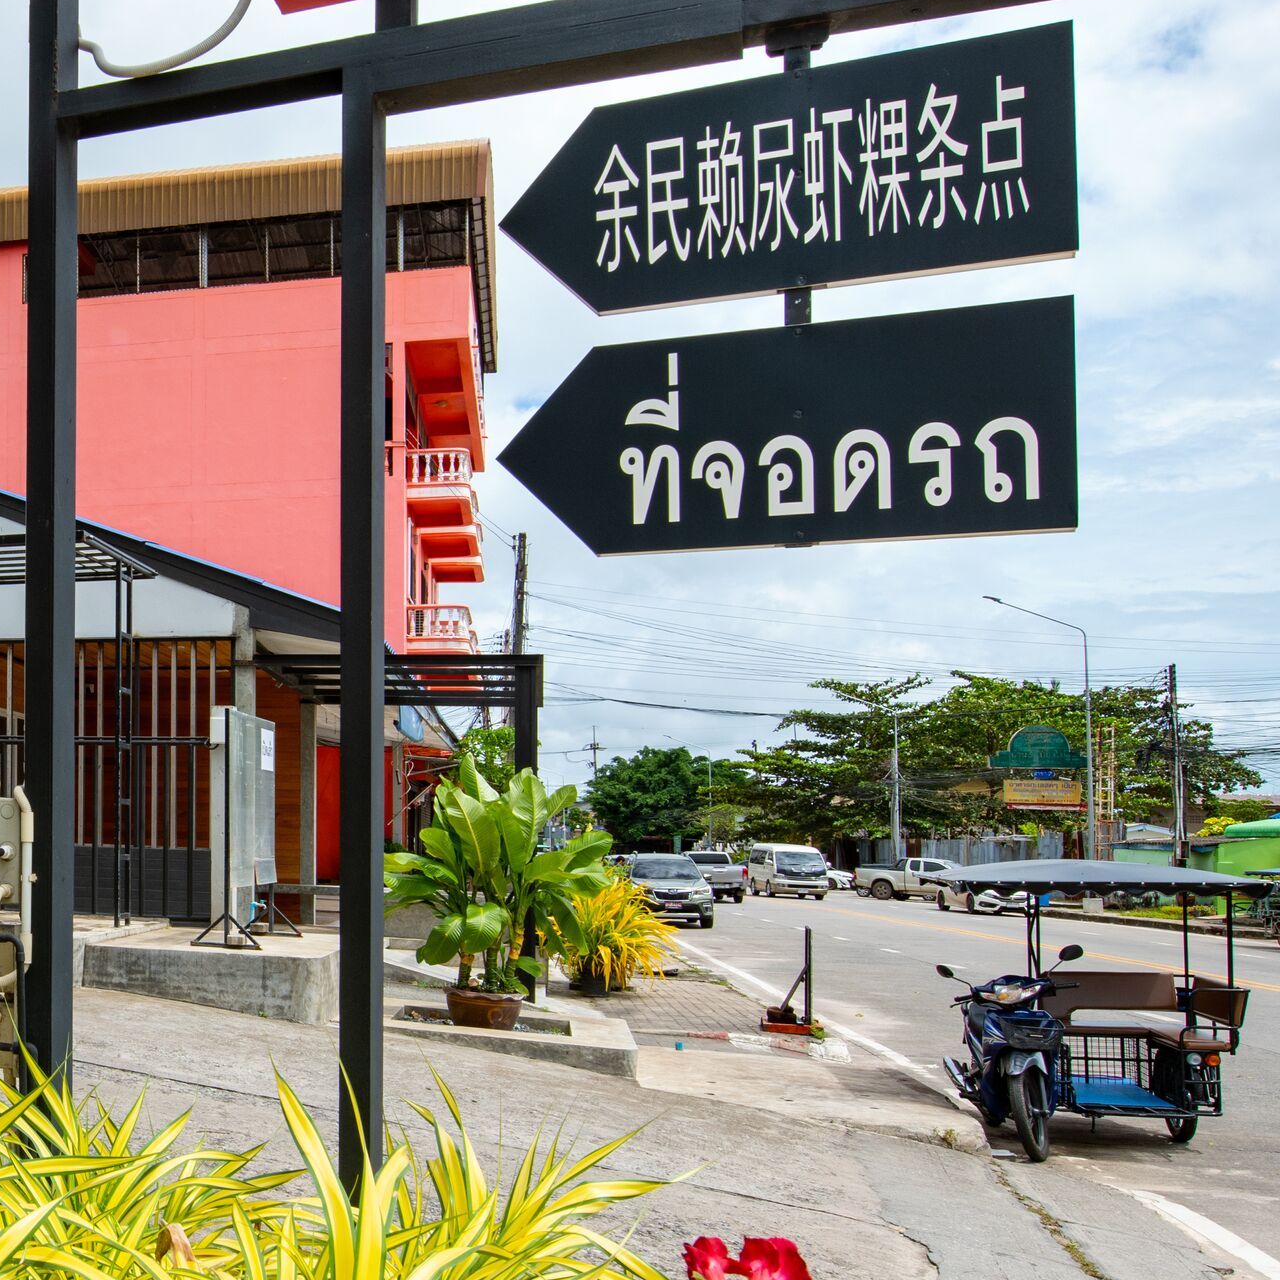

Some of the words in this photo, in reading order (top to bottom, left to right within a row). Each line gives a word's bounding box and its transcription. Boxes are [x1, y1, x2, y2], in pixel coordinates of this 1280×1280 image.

[593, 74, 1031, 273] 余民赖尿虾粿条点
[620, 352, 1041, 525] ที่จอดรถ
